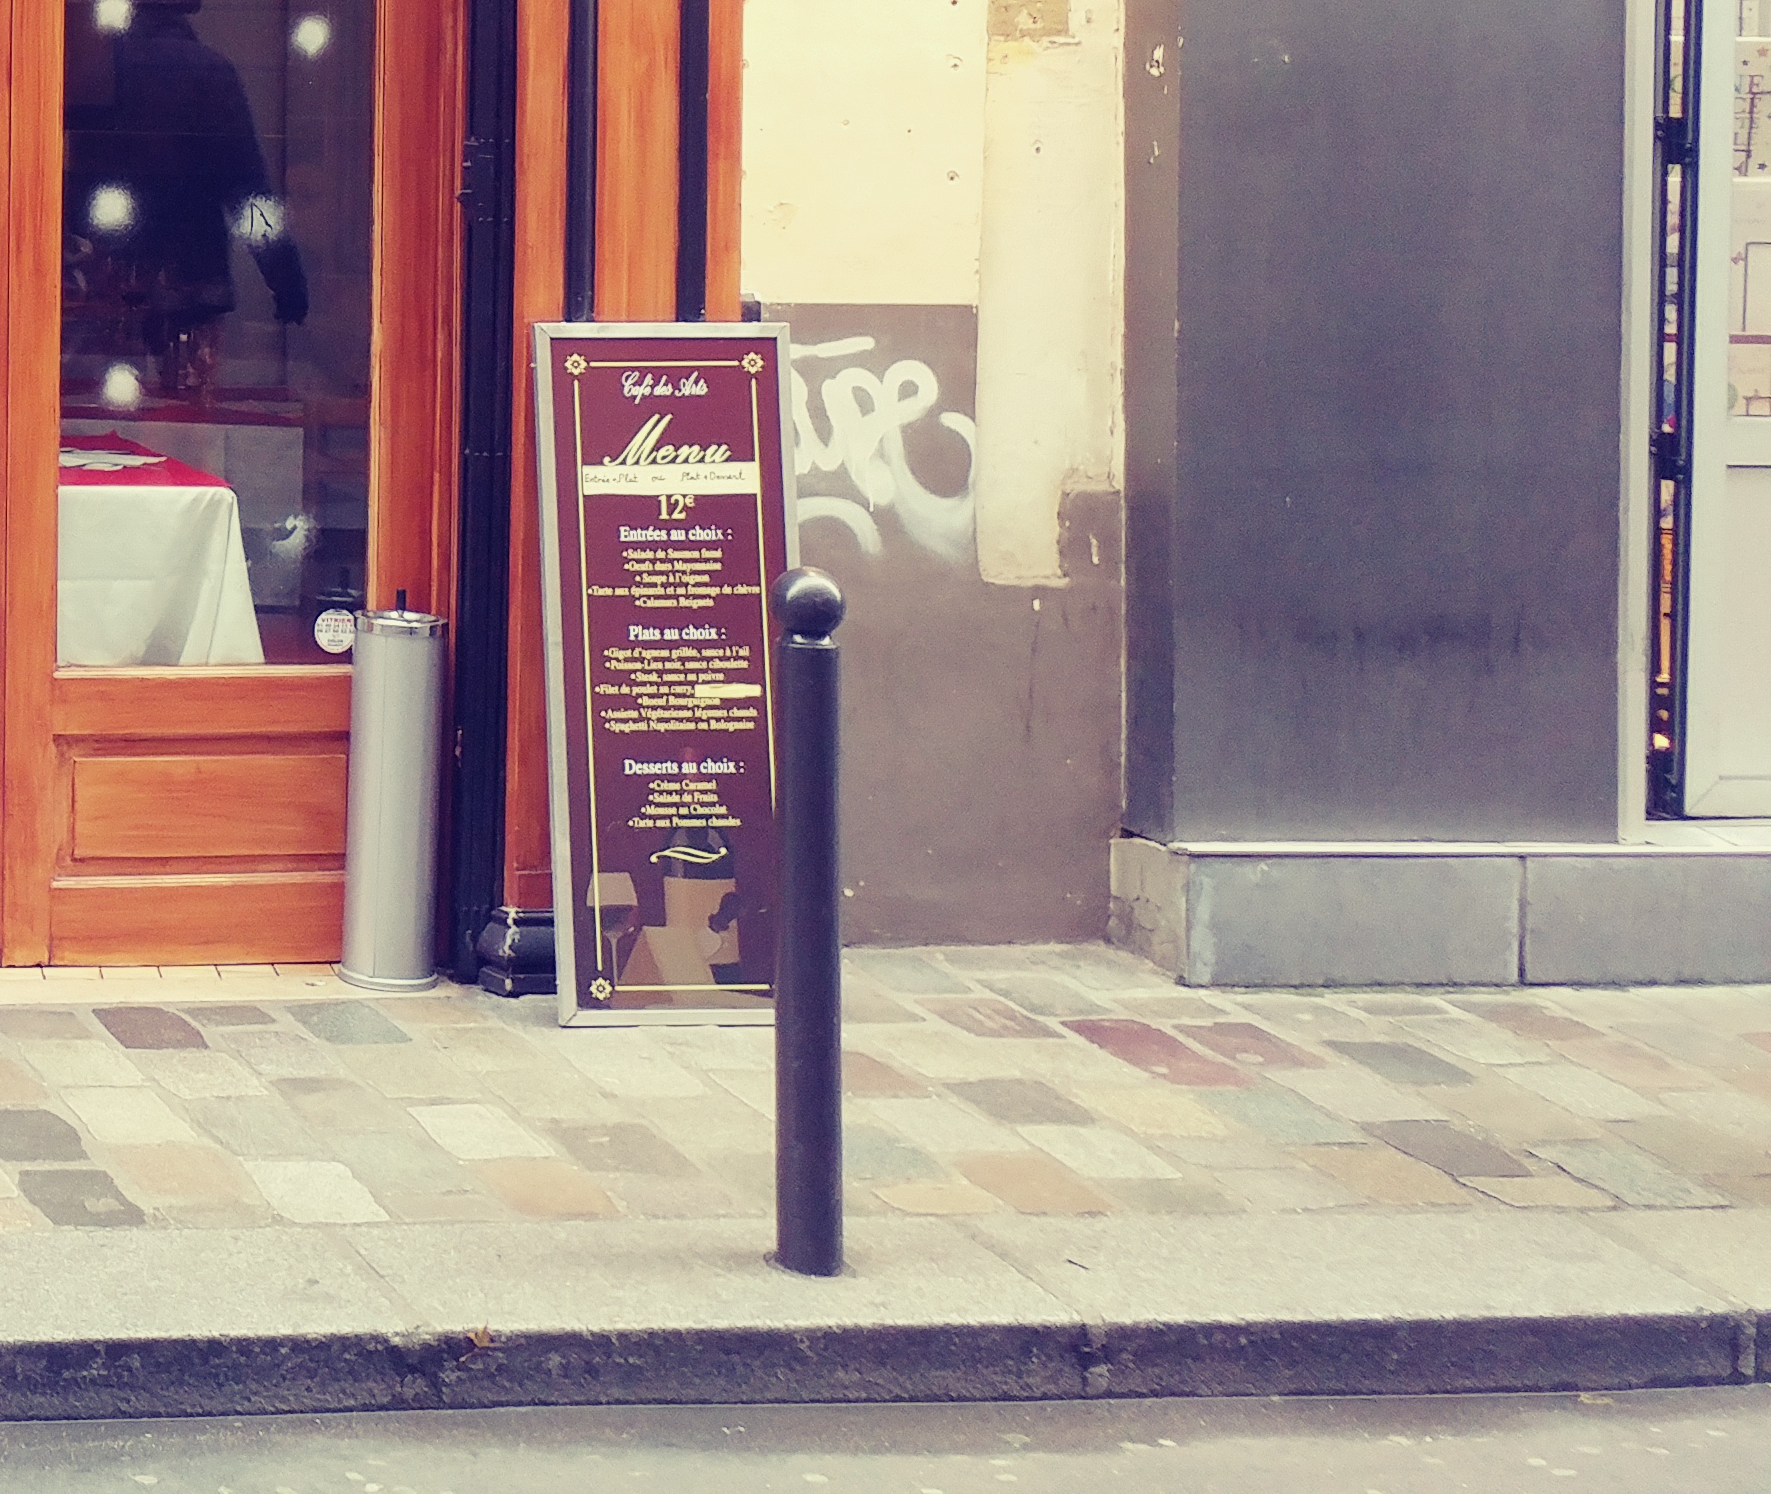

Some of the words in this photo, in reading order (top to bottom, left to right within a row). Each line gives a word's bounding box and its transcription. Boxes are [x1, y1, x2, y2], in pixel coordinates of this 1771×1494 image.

[621, 371, 654, 405] Café
[653, 375, 674, 396] des
[674, 370, 708, 397] Arts
[602, 413, 732, 466] Menu
[619, 525, 668, 542] Entrées
[669, 531, 686, 541] au
[688, 525, 724, 541] choix
[642, 573, 667, 584] Soupe
[628, 625, 661, 641] Plats
[663, 629, 680, 640] au
[681, 624, 719, 640] choix
[623, 758, 679, 775] Desserts
[681, 763, 697, 774] au
[699, 758, 737, 774] choix
